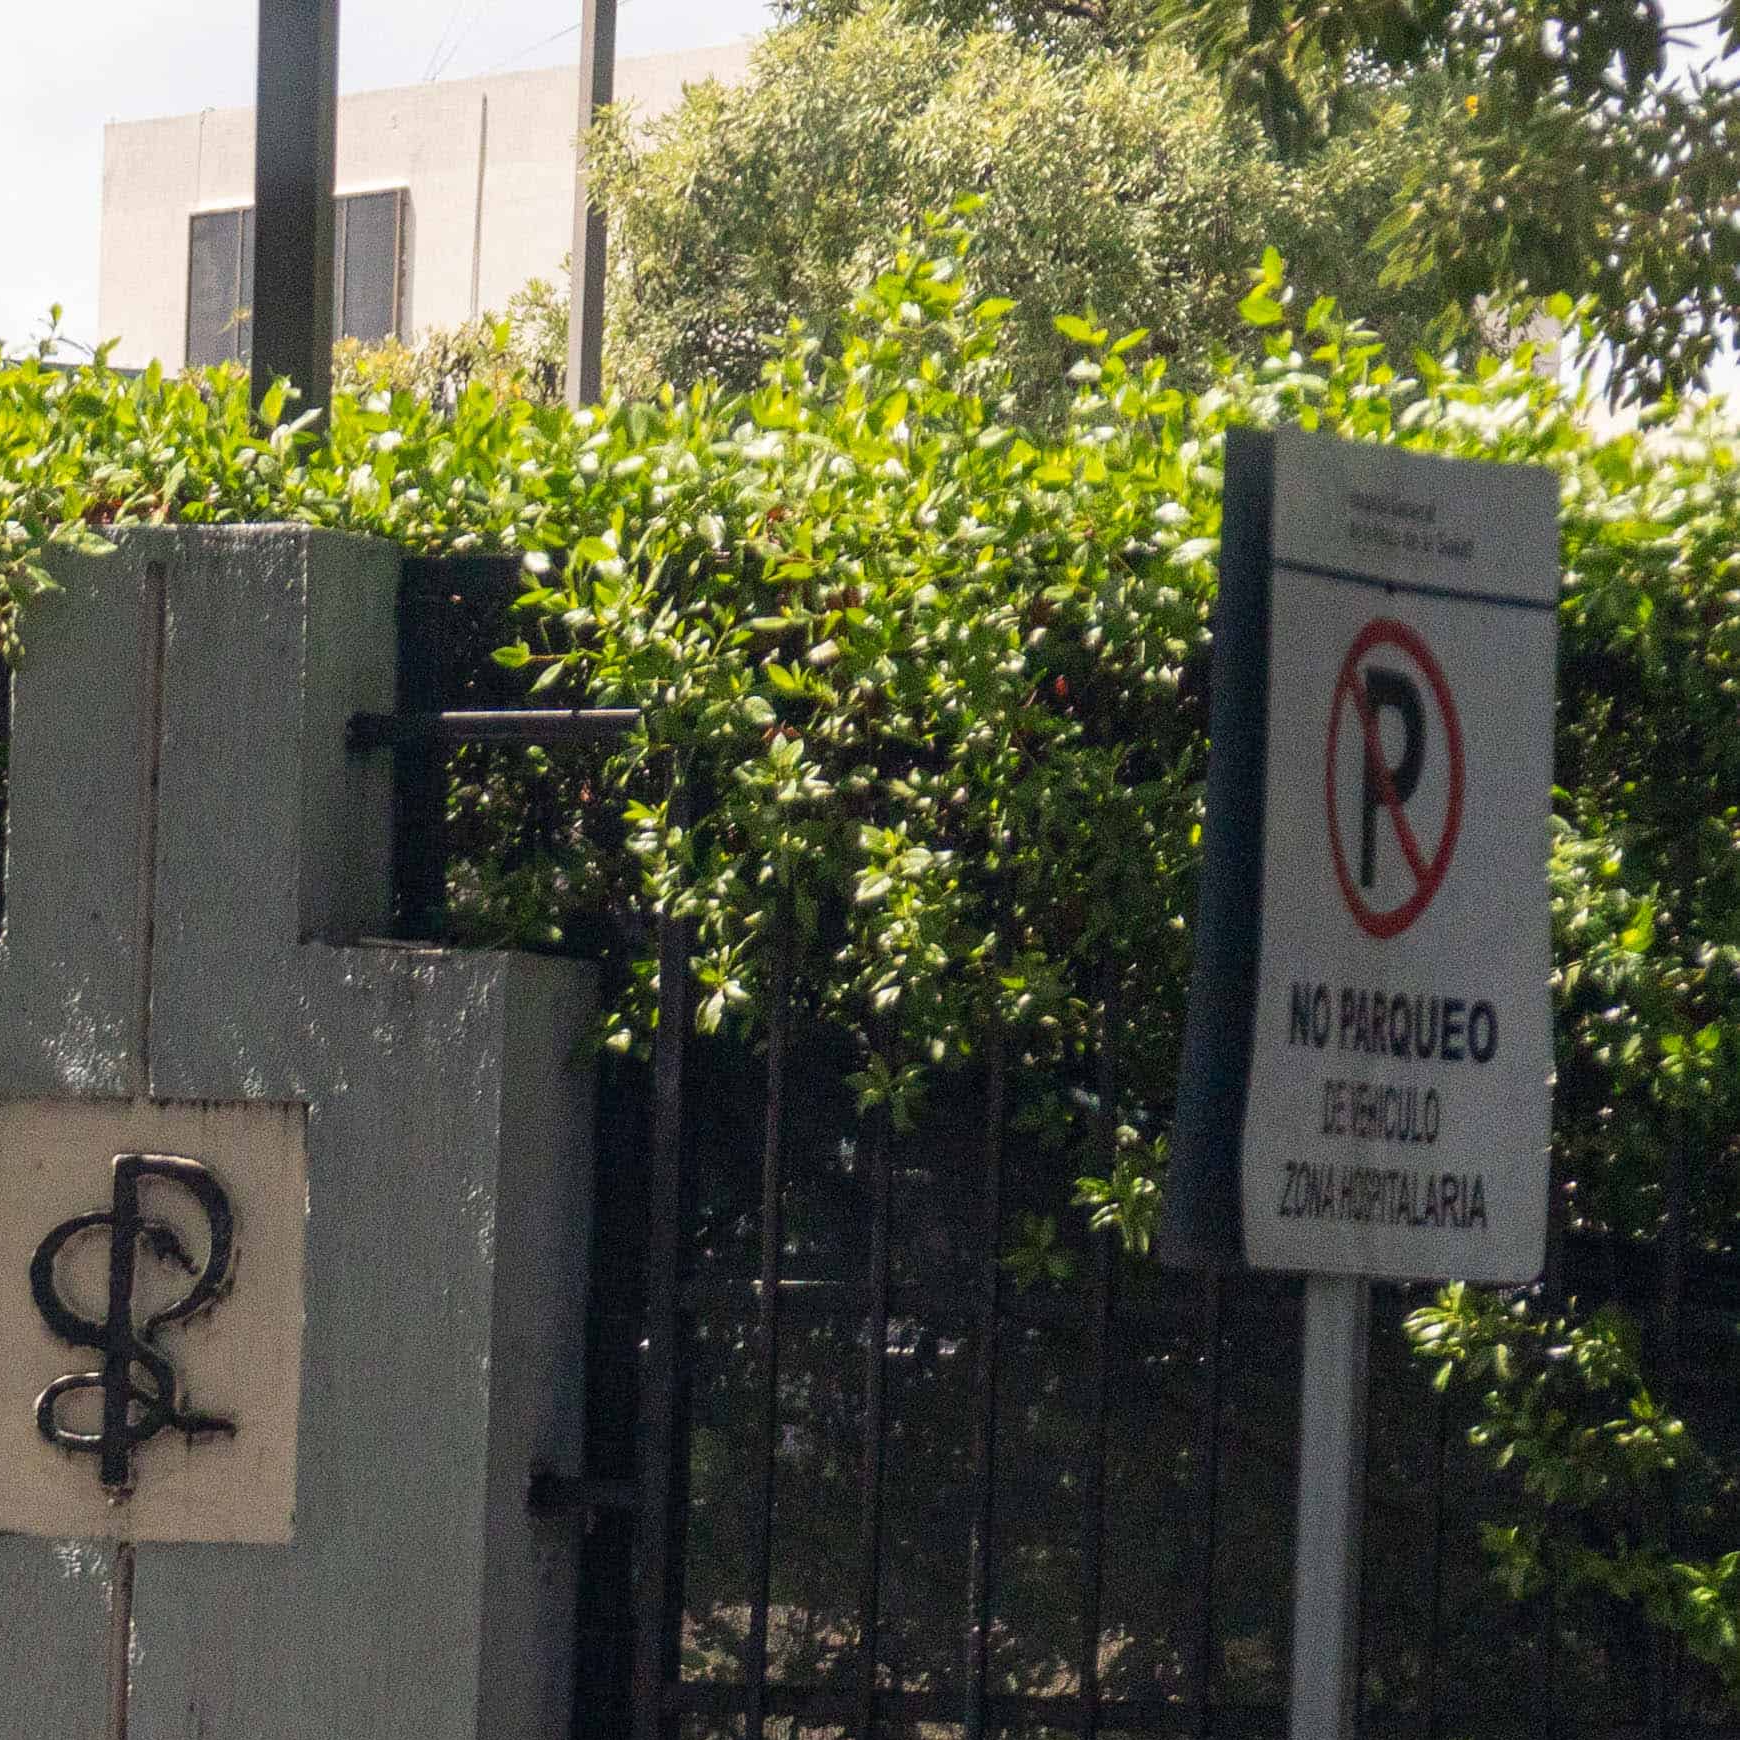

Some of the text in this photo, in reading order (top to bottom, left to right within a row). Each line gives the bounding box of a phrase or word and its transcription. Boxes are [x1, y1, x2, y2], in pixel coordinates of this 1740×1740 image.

[1289, 982, 1498, 1064] NO PARQUEO
[1278, 1160, 1488, 1229] ZONA HOSPITALARIA
